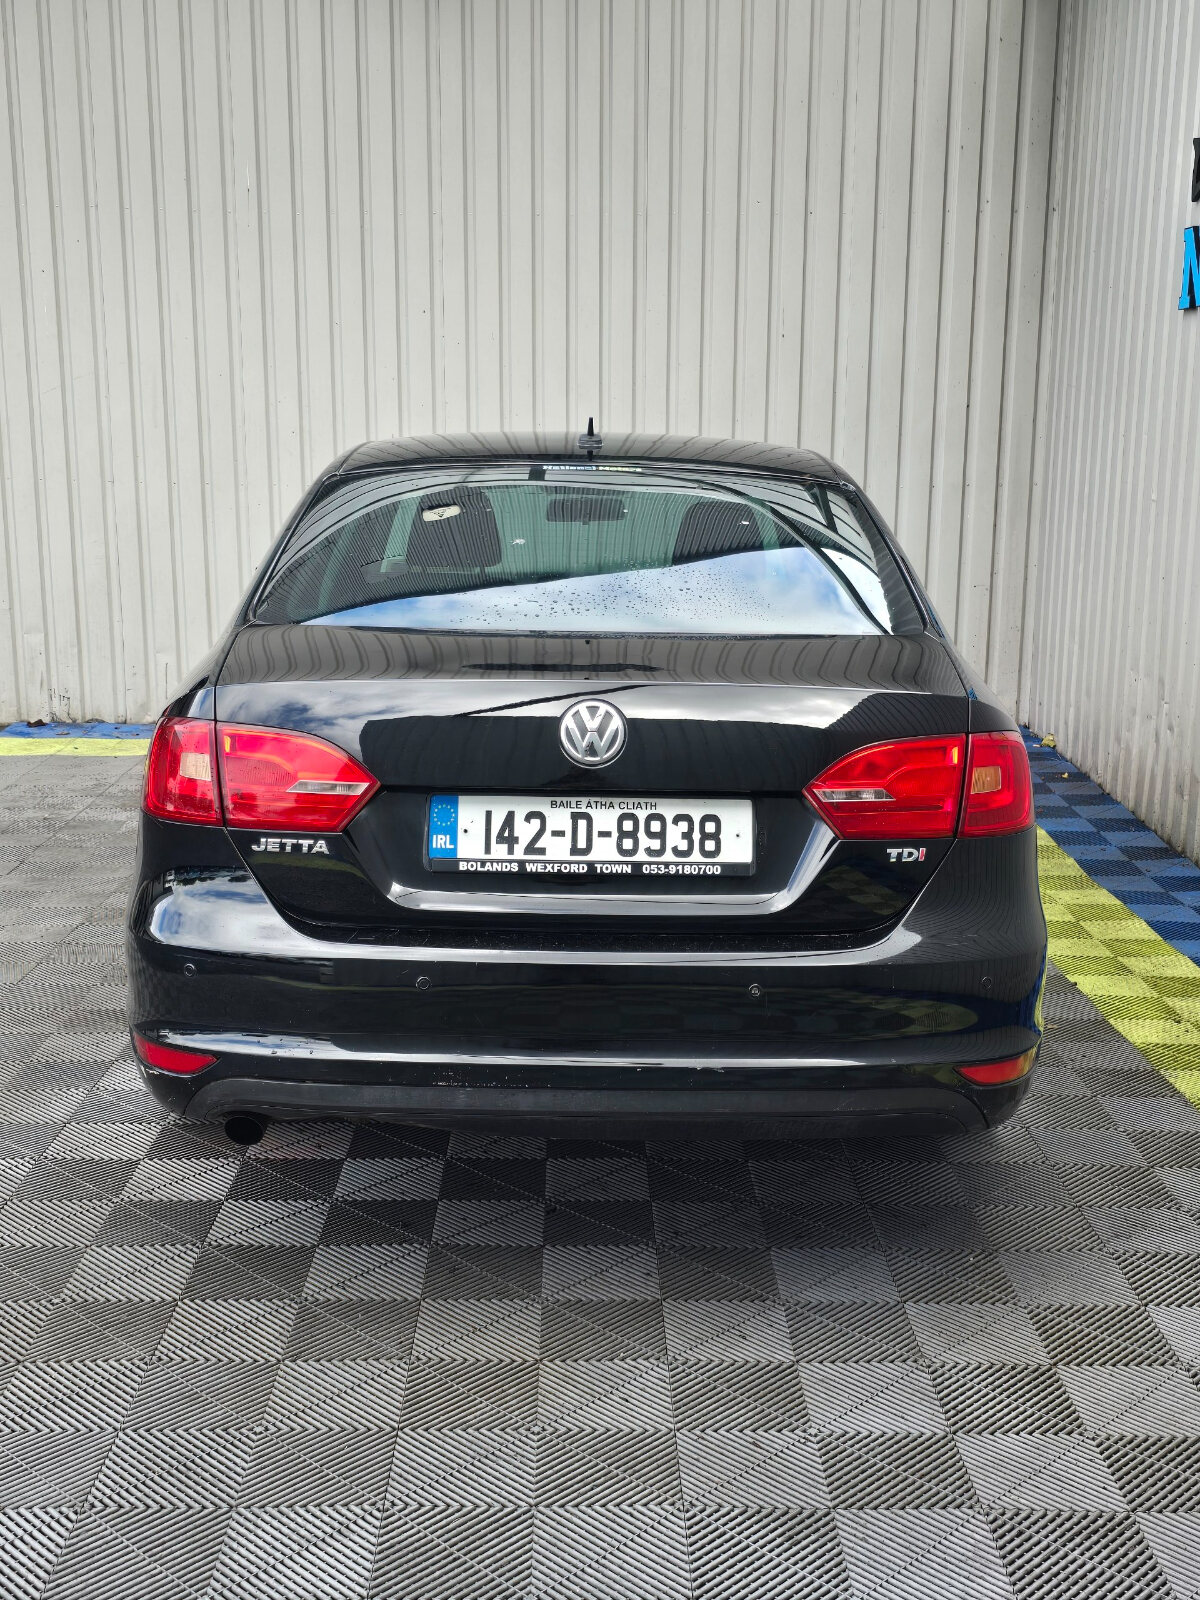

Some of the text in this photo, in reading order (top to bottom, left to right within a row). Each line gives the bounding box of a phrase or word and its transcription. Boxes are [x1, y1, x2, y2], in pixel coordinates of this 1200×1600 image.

[550, 799, 657, 811] BAILE ÁTHA CLIATH
[432, 834, 455, 849] IRL
[484, 810, 722, 859] 142-D-8938
[251, 838, 330, 855] JETTA
[886, 847, 926, 862] TDI
[459, 861, 722, 875] BOLANDS WEXFORD TOWN 053-9180700
